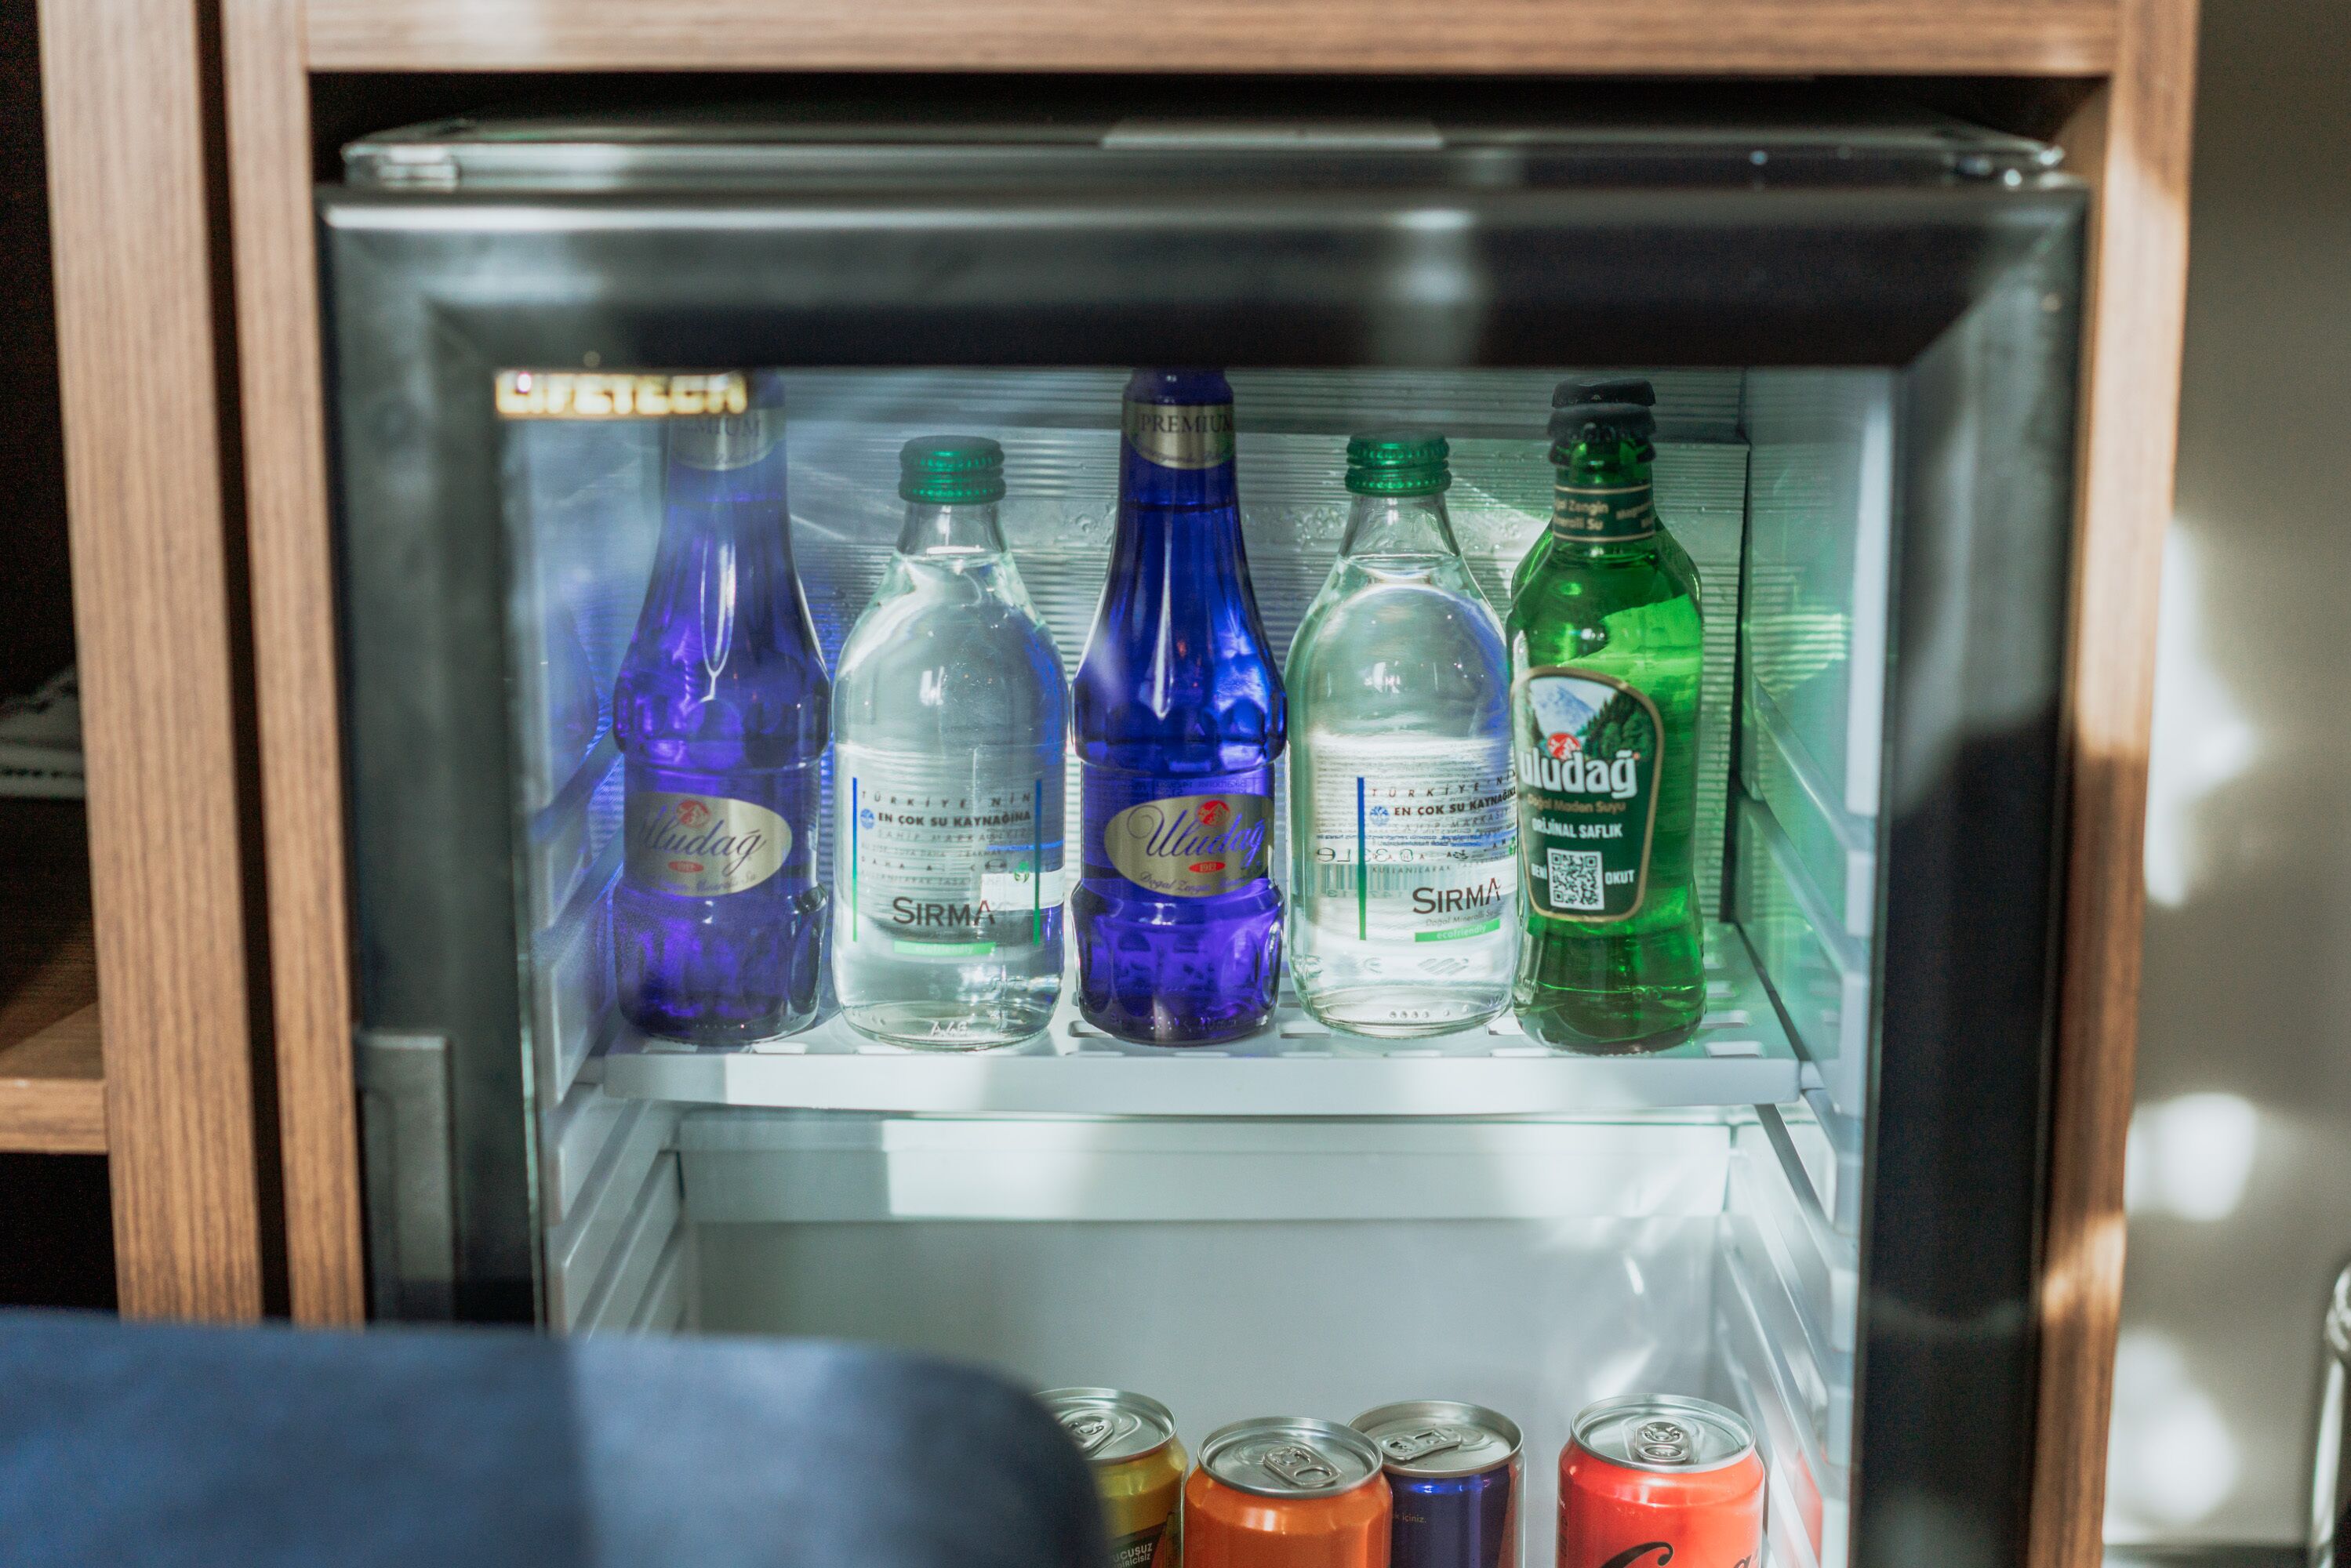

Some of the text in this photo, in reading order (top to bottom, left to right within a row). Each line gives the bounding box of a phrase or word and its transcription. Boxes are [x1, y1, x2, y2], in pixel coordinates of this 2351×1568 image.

[1394, 808, 1412, 816] EN
[1449, 803, 1466, 813] SU
[878, 812, 893, 822] EN
[898, 815, 925, 827] ÇOK
[930, 817, 948, 826] SU
[1126, 804, 1266, 872] Uludağ
[1578, 822, 1624, 840] SAFLIK
[1604, 869, 1635, 885] OKUT
[1412, 877, 1503, 915] SIRMA
[892, 896, 996, 926] SIRMA
[1436, 924, 1488, 939] ecofriendly
